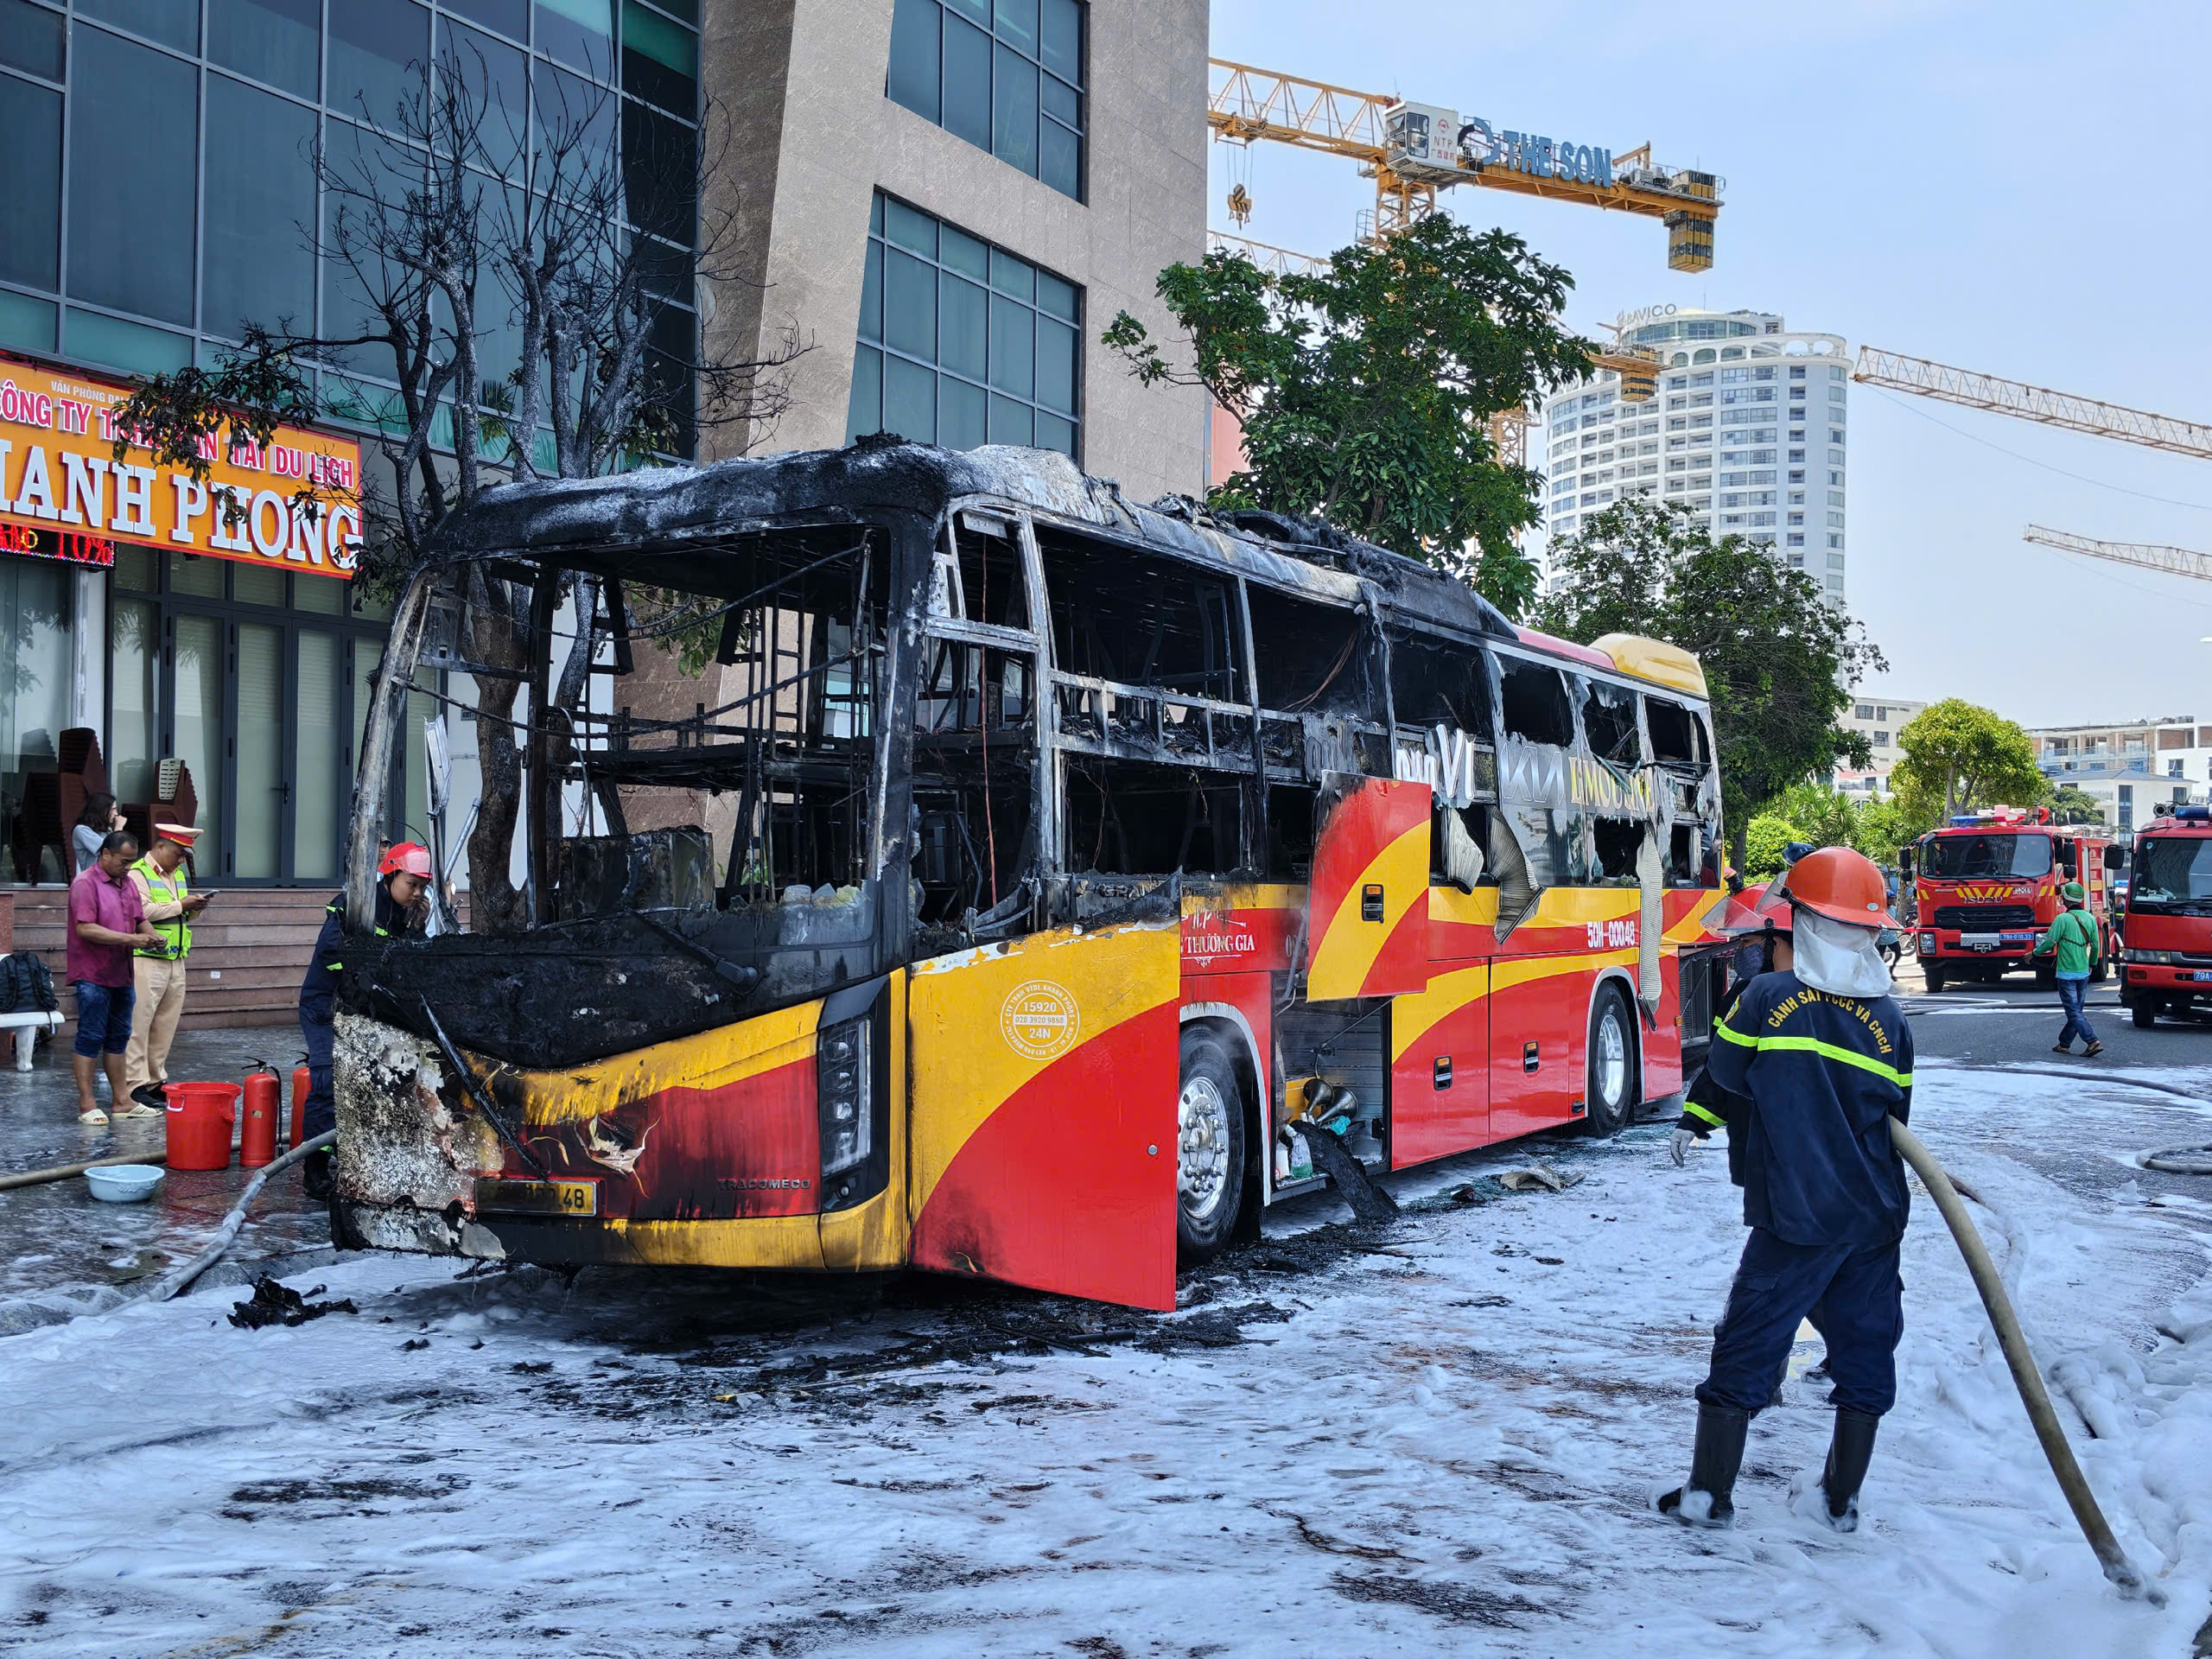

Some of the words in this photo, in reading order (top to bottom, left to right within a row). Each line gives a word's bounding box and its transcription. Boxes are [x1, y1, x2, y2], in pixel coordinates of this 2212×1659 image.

[1433, 136, 1452, 148] NTP
[1503, 130, 1553, 179] THE
[1560, 141, 1611, 188] SON
[51, 380, 71, 394] VĂN
[73, 385, 105, 402] PHÒNG
[0, 378, 53, 429] ÔNG
[60, 397, 92, 435] TY
[274, 444, 302, 478] DU
[309, 452, 354, 490] LỊCH
[0, 439, 156, 536] ANH
[172, 474, 364, 569] PHONG
[58, 531, 112, 563] 10%
[1235, 934, 1255, 952] GIA
[1023, 1001, 1057, 1013] 15920
[1062, 996, 1075, 1018] PHONG
[1029, 1027, 1052, 1039] 24N
[1768, 996, 1799, 1028] CẢNH
[1854, 1004, 1872, 1024] VÀ
[1868, 1020, 1893, 1054] CNCH
[716, 1178, 810, 1191] TRACOMECO
